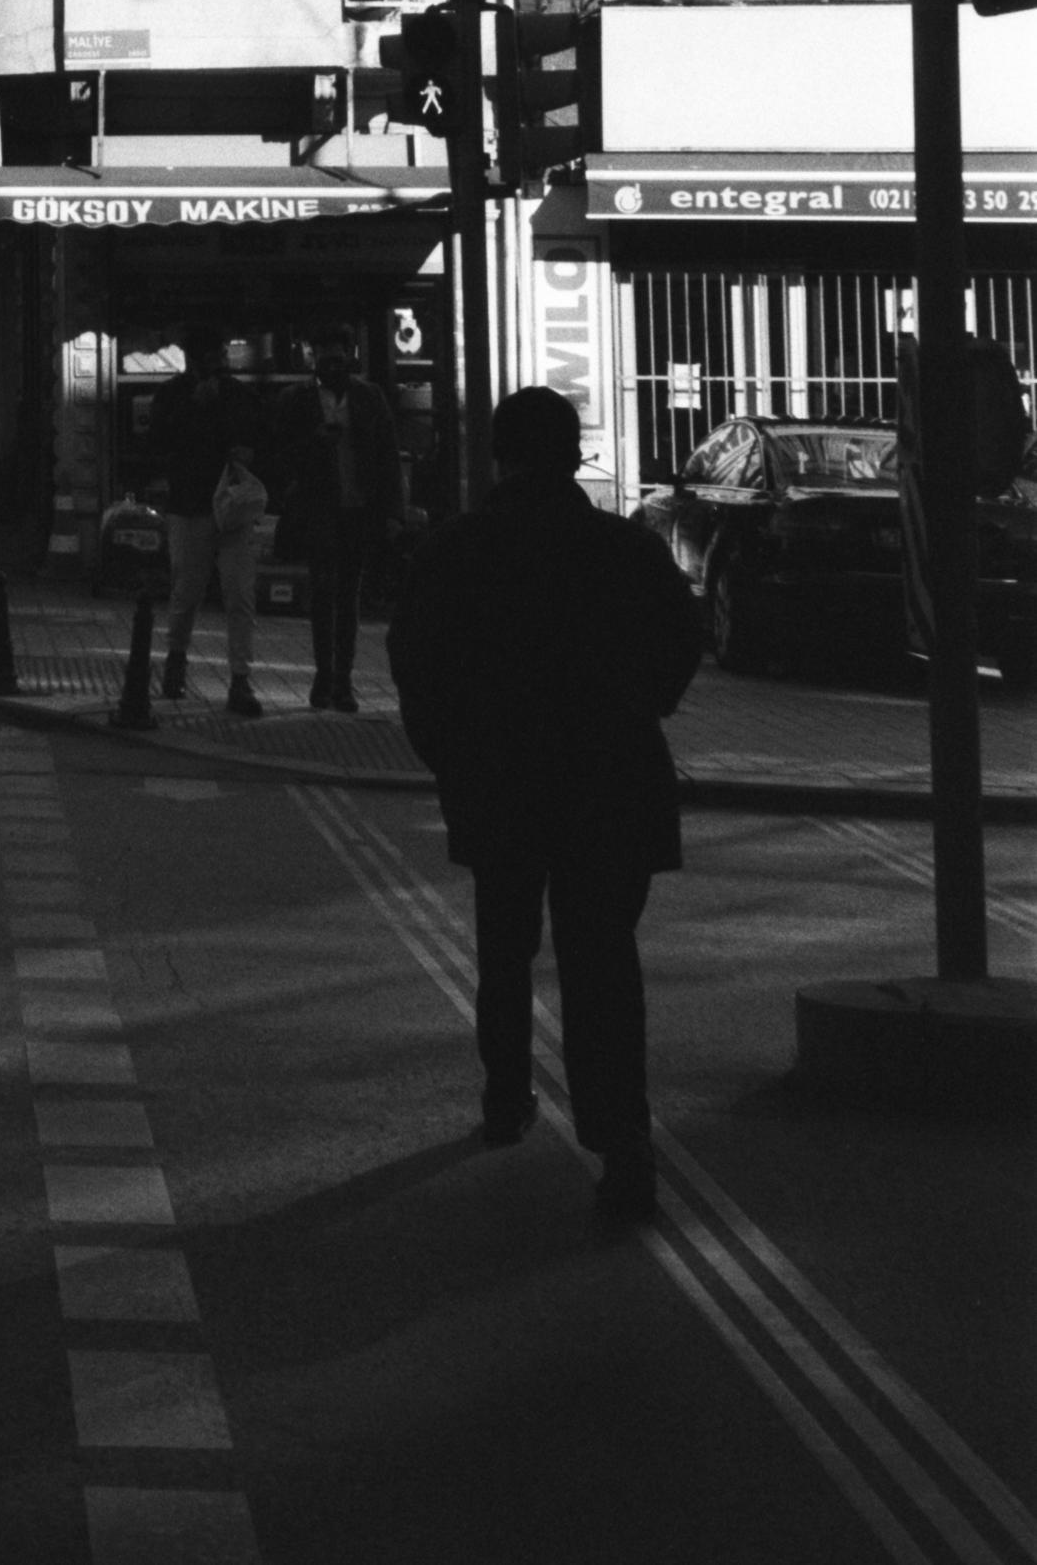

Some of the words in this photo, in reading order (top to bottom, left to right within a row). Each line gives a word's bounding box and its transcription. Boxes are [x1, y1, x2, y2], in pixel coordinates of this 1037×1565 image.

[68, 35, 113, 49] MALİYE
[12, 197, 153, 223] GÖKSOY
[179, 197, 320, 221] MAKİNE
[670, 185, 843, 215] entegral
[869, 189, 917, 210] (021
[983, 190, 1008, 210] 50
[543, 247, 591, 406] WILO
